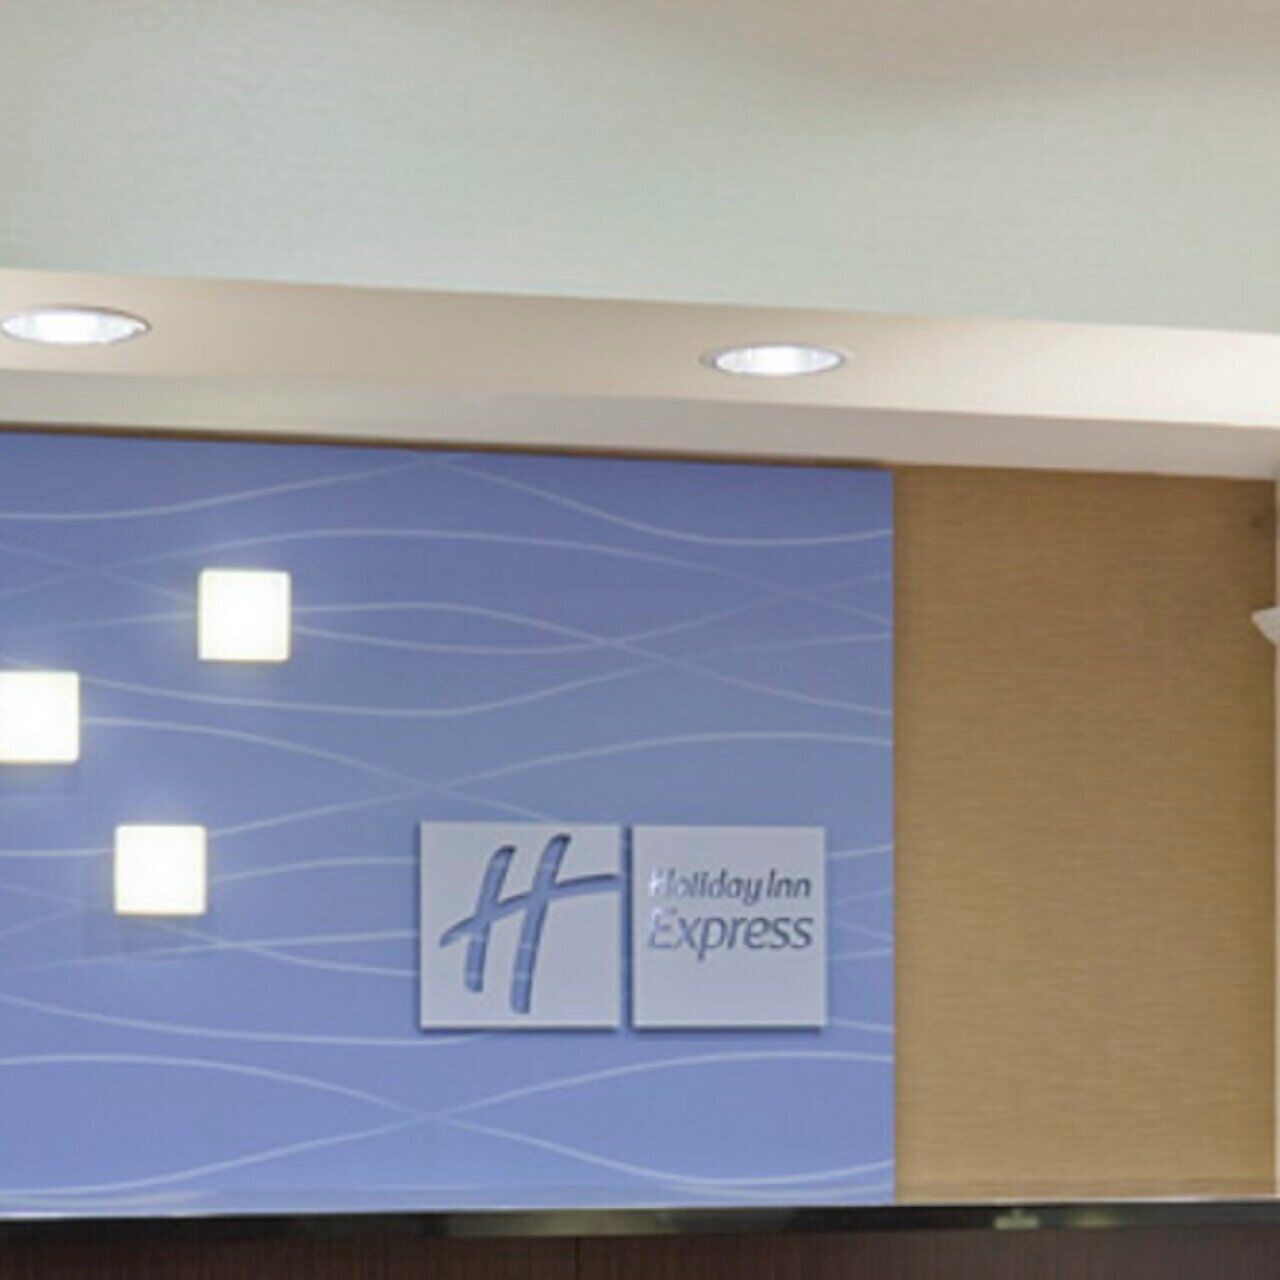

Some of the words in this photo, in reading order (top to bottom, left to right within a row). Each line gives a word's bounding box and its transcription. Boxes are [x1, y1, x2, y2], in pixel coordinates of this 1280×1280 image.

[649, 867, 763, 904] Holiday
[766, 869, 812, 899] Inn
[439, 832, 619, 1015] H
[648, 907, 814, 961] Express
